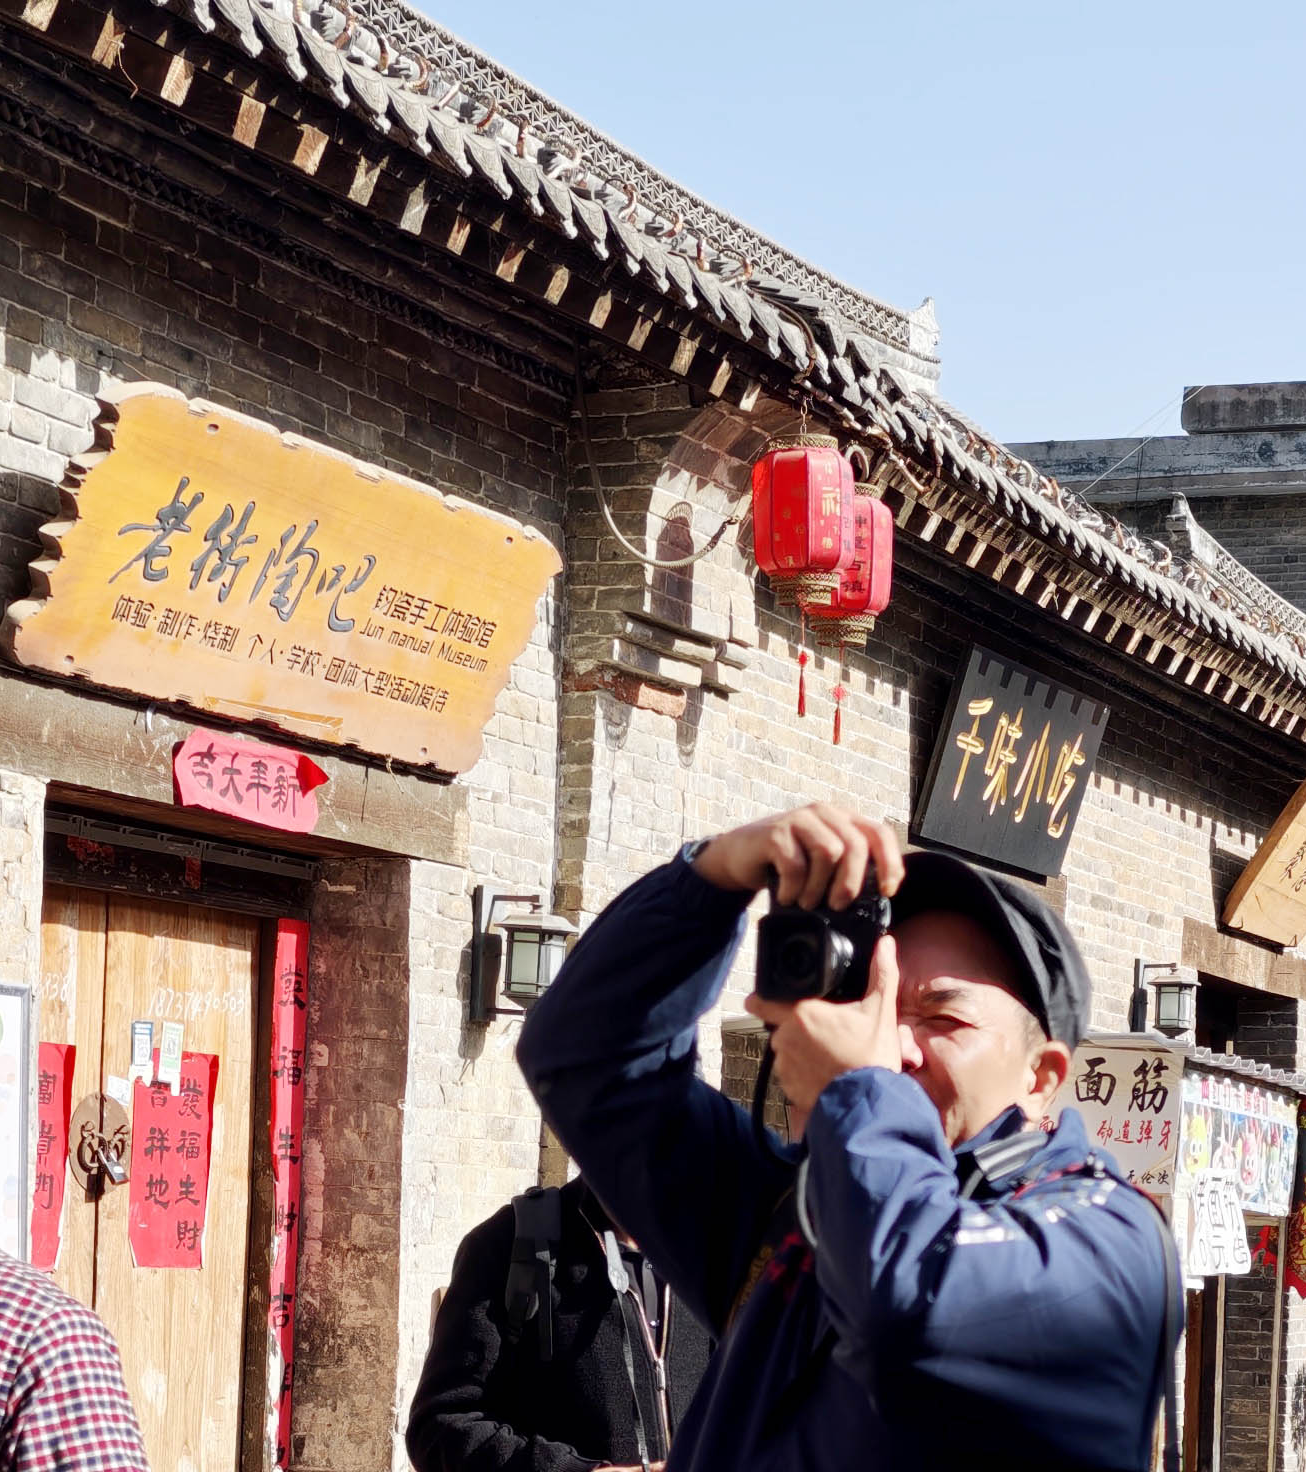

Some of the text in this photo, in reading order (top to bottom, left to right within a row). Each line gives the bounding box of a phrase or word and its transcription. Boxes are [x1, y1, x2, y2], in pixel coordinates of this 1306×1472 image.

[109, 476, 377, 633] 老街陶吧
[359, 617, 489, 672] Jun manual Museum
[371, 583, 498, 651] 钧瓷手工体验馆
[1075, 1056, 1170, 1115] 面筋
